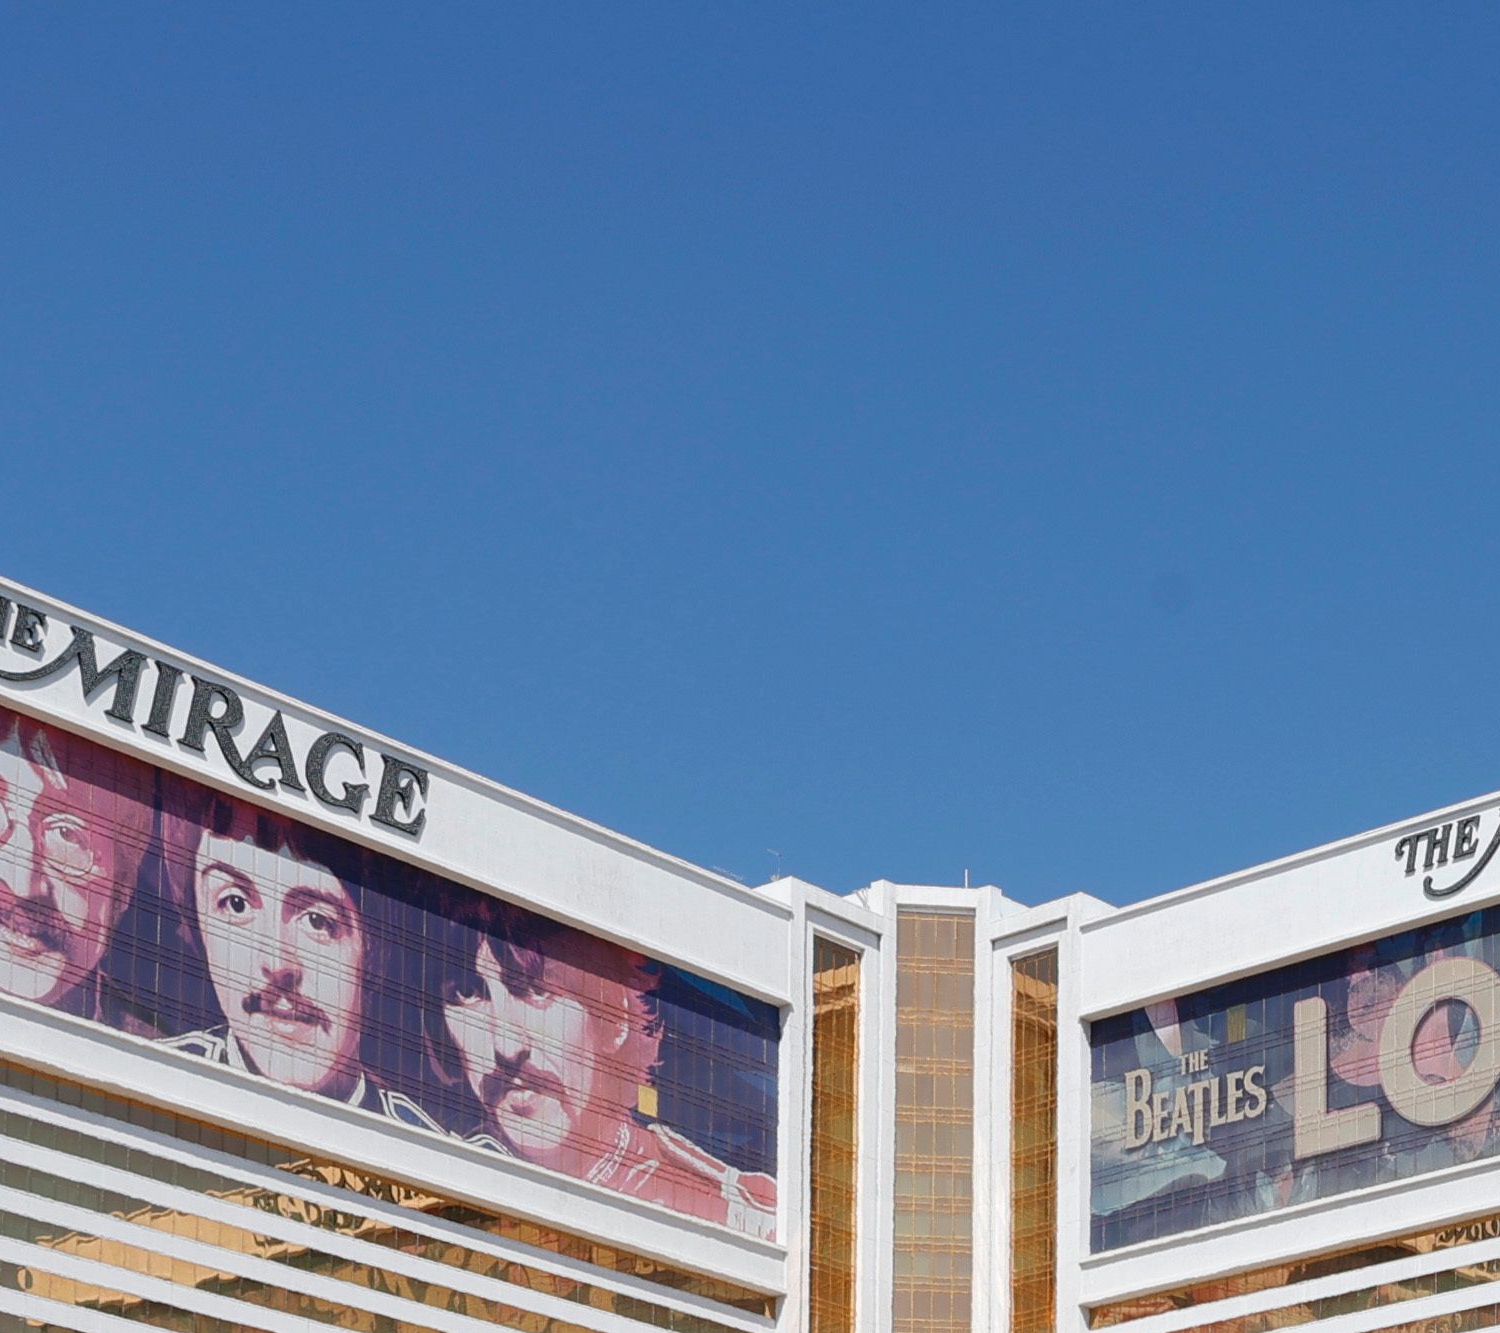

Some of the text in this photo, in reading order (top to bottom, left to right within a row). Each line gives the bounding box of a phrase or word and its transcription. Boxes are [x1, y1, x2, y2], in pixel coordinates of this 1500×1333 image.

[1396, 815, 1480, 875] THE
[1180, 1049, 1209, 1076] THE
[1124, 1065, 1268, 1149] BEATLES
